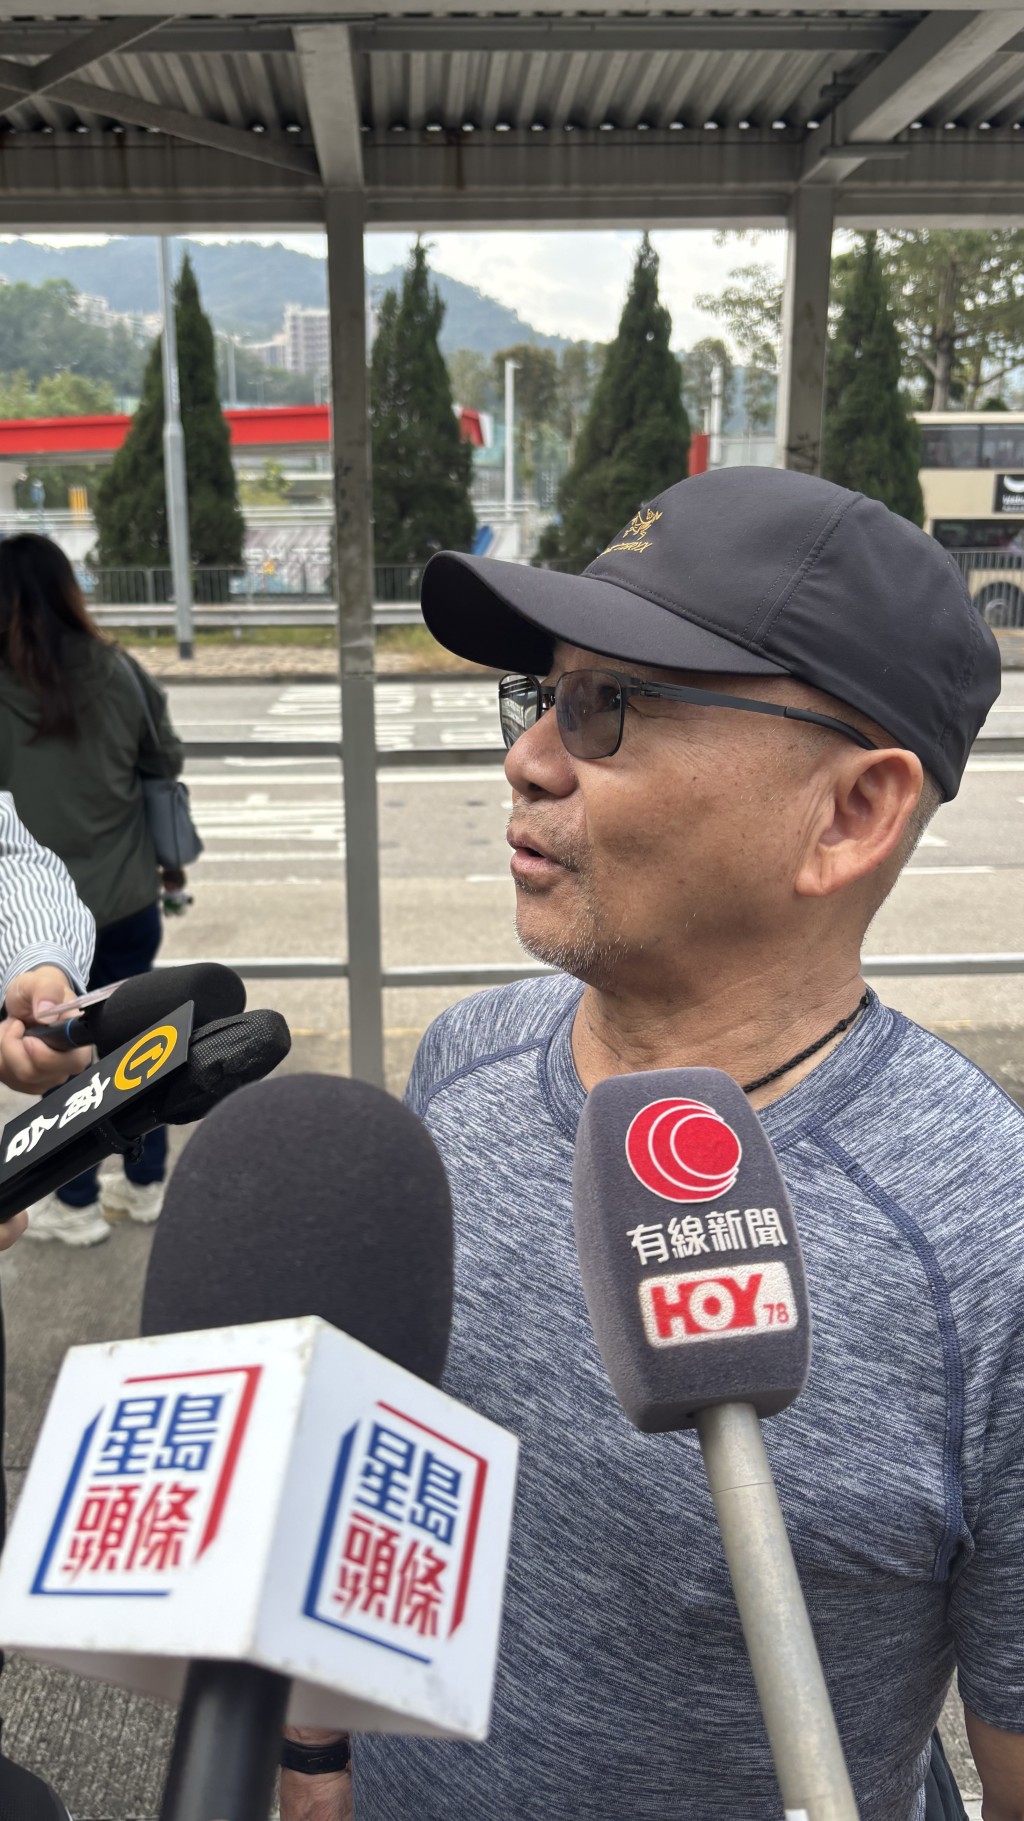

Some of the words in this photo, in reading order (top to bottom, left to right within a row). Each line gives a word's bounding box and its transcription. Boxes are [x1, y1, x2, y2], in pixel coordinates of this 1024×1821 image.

[5, 1072, 110, 1162] 商台
[626, 1207, 788, 1265] 有線新聞
[651, 1273, 763, 1338] HOY
[763, 1303, 789, 1325] 78
[94, 1393, 224, 1477] 星島
[353, 1423, 462, 1546] 星島
[62, 1482, 199, 1580] 頭條
[333, 1513, 448, 1637] 頭條
